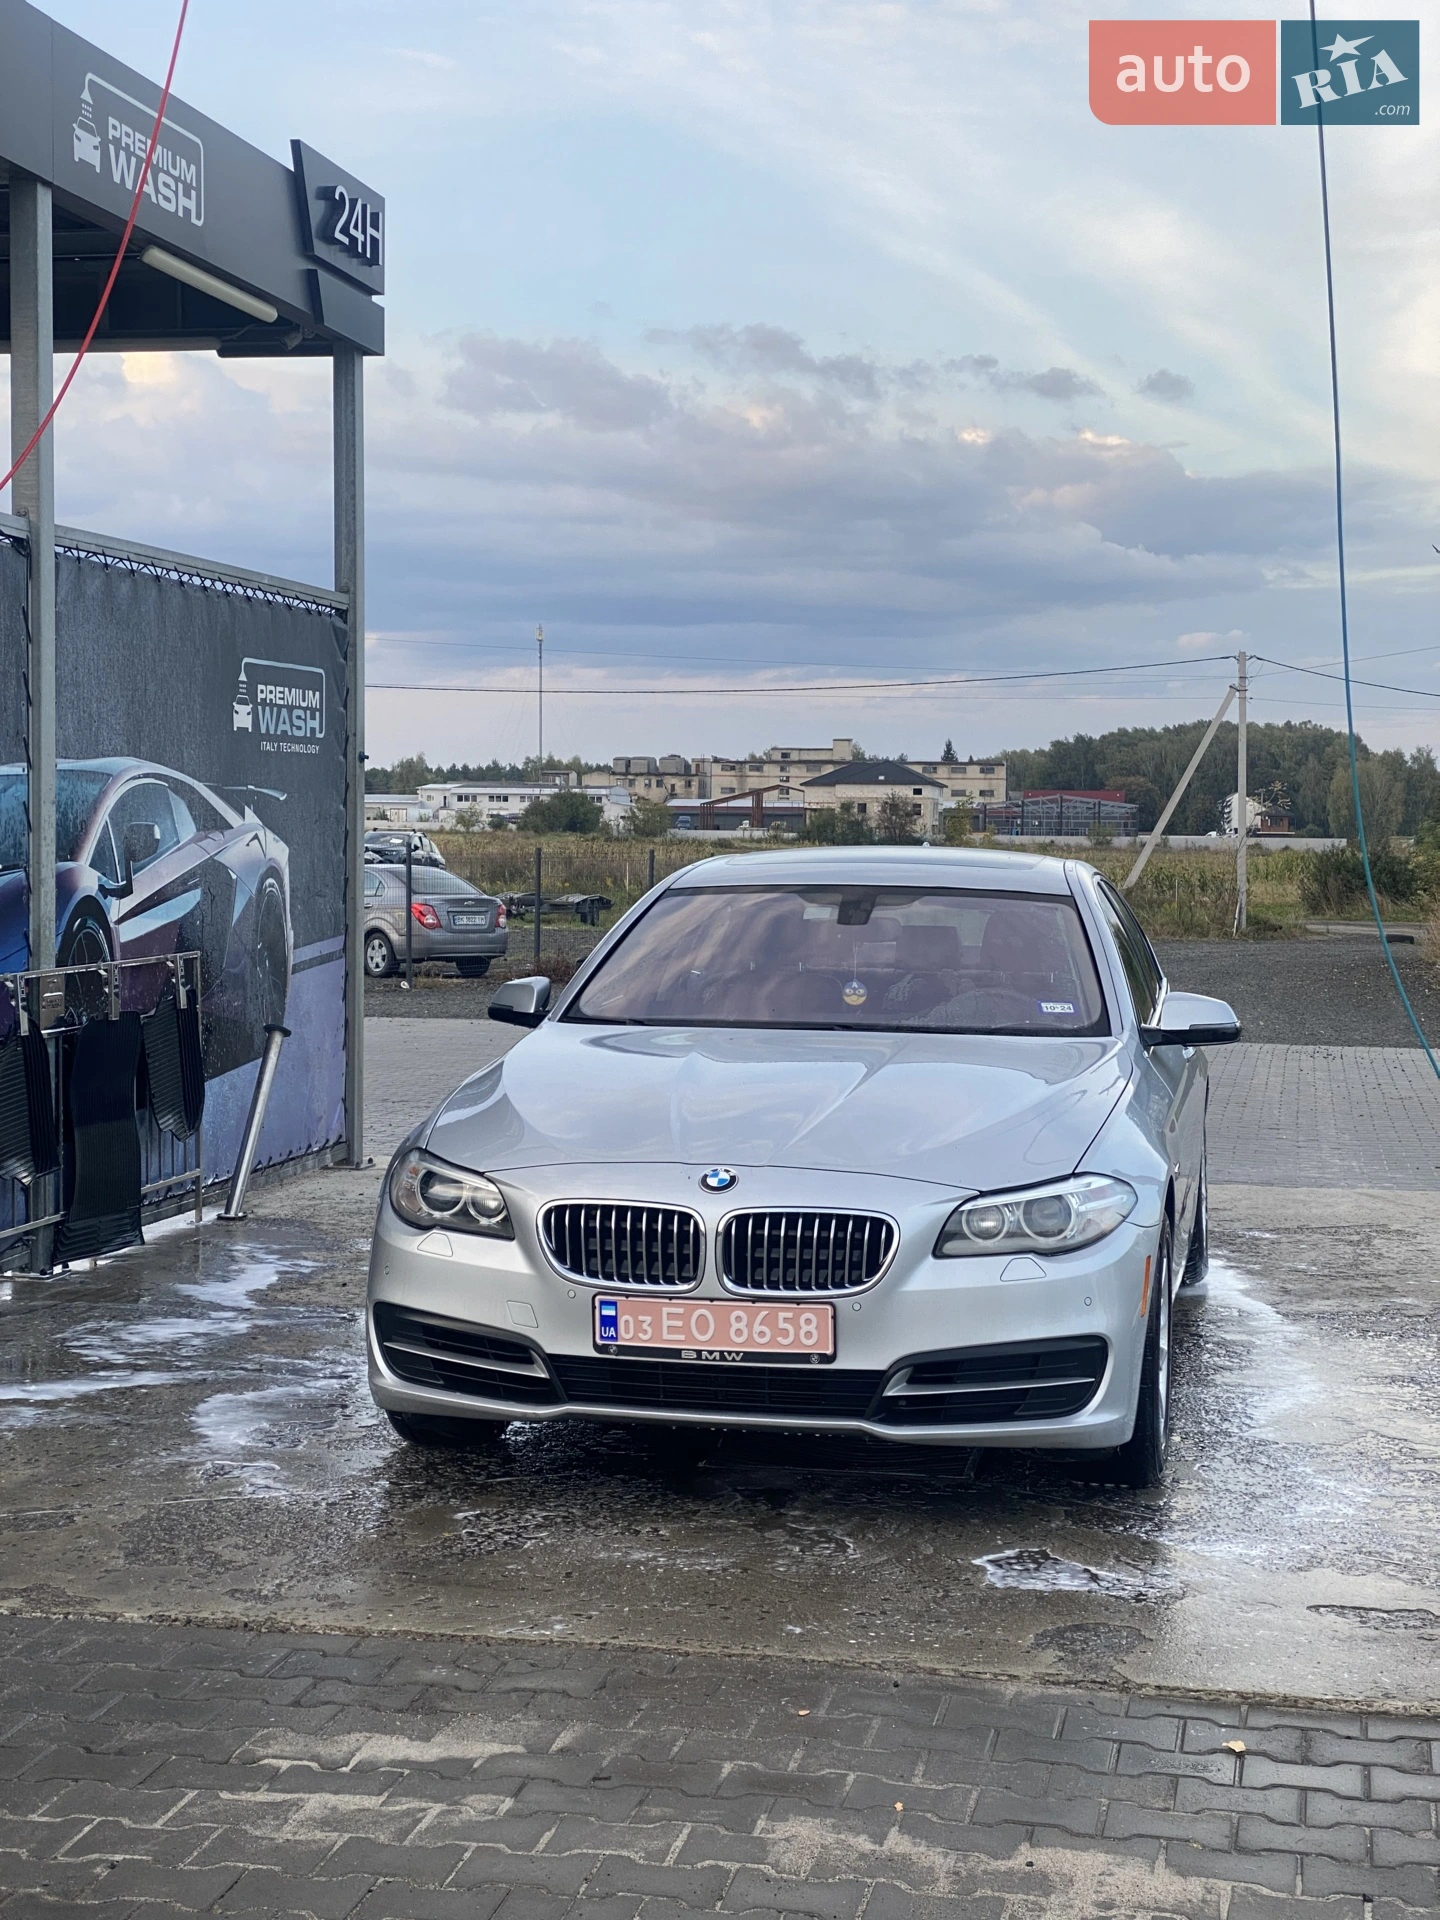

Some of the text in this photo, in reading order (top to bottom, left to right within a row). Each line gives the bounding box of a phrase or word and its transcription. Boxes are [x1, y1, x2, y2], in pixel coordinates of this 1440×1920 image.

[108, 116, 197, 188] PREMIUM
[108, 143, 198, 226] WASH
[334, 184, 383, 266] 24H
[257, 684, 320, 709] PREMIUM
[257, 705, 320, 738] WASH
[260, 741, 320, 754] ITALY TECHNOLOGY
[601, 1326, 616, 1338] UA
[620, 1307, 819, 1346] 03 EO 8658
[681, 1350, 744, 1362] BMW
